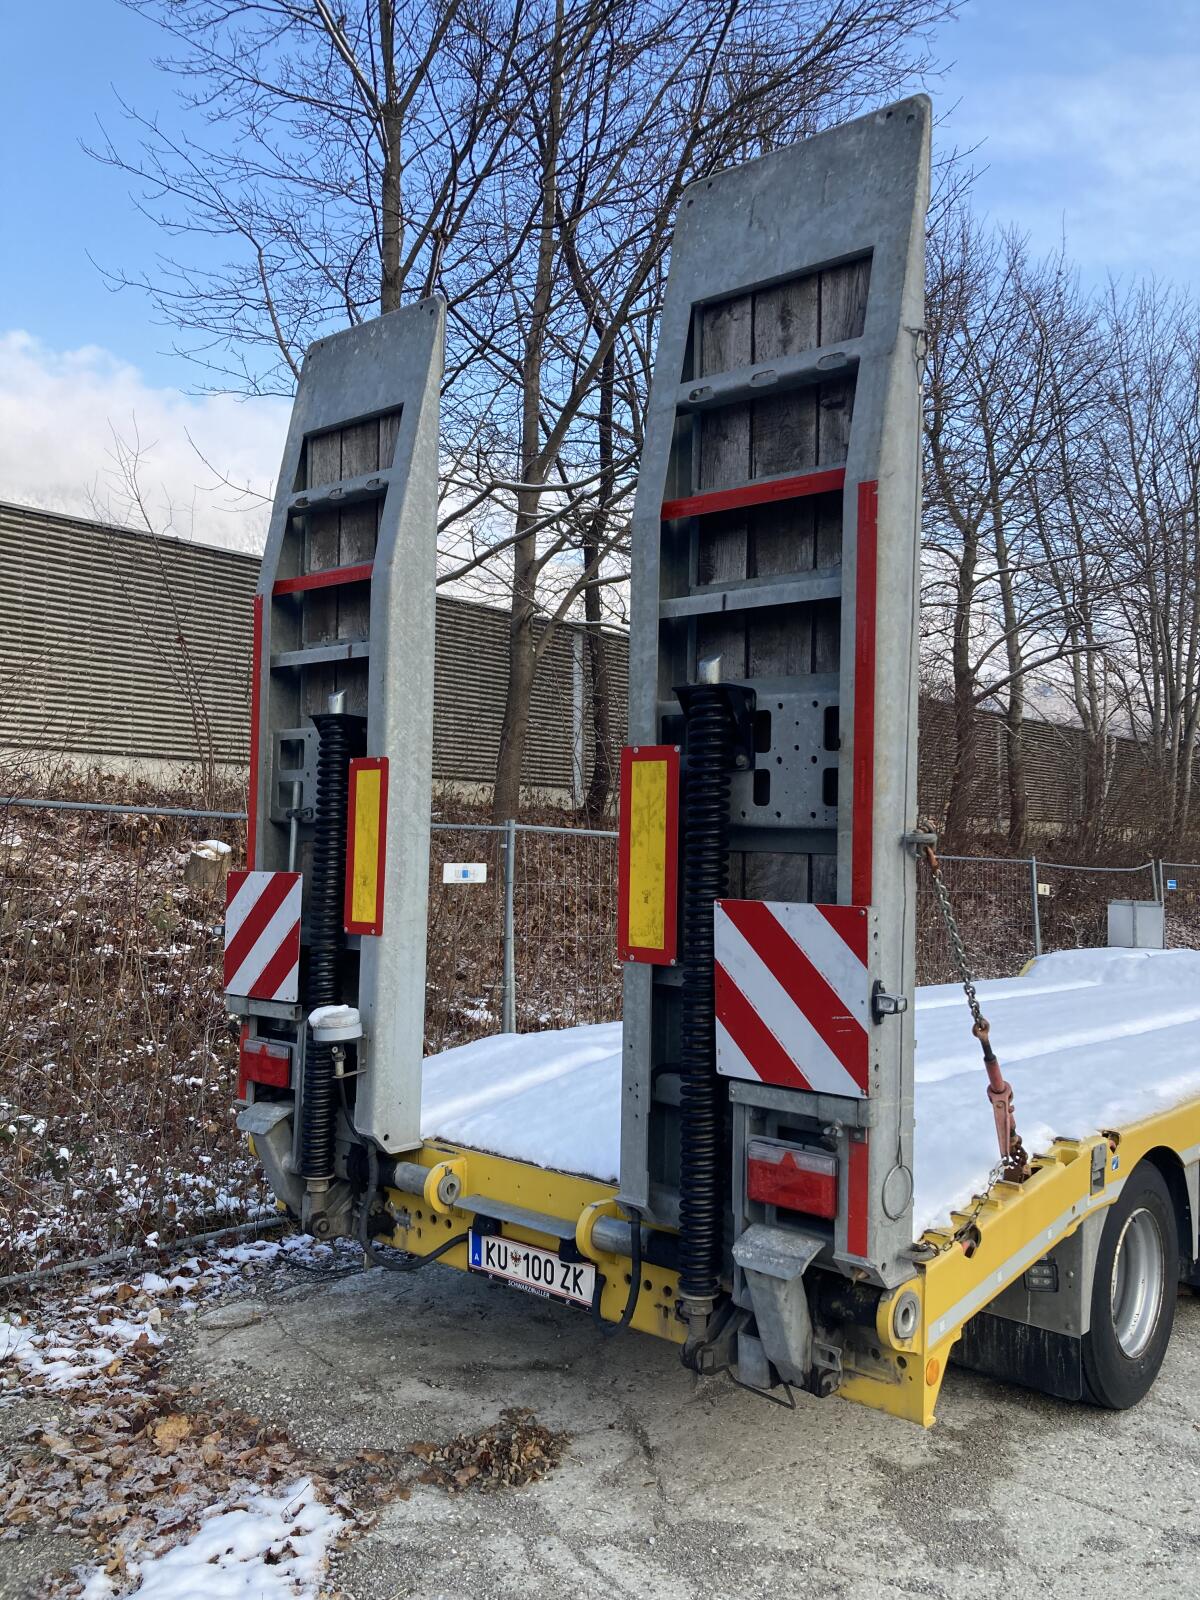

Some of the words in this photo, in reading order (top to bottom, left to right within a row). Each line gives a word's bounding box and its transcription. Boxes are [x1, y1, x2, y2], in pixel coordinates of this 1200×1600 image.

[486, 1240, 508, 1270] KU
[523, 1252, 555, 1285] 100
[560, 1263, 584, 1295] ZK
